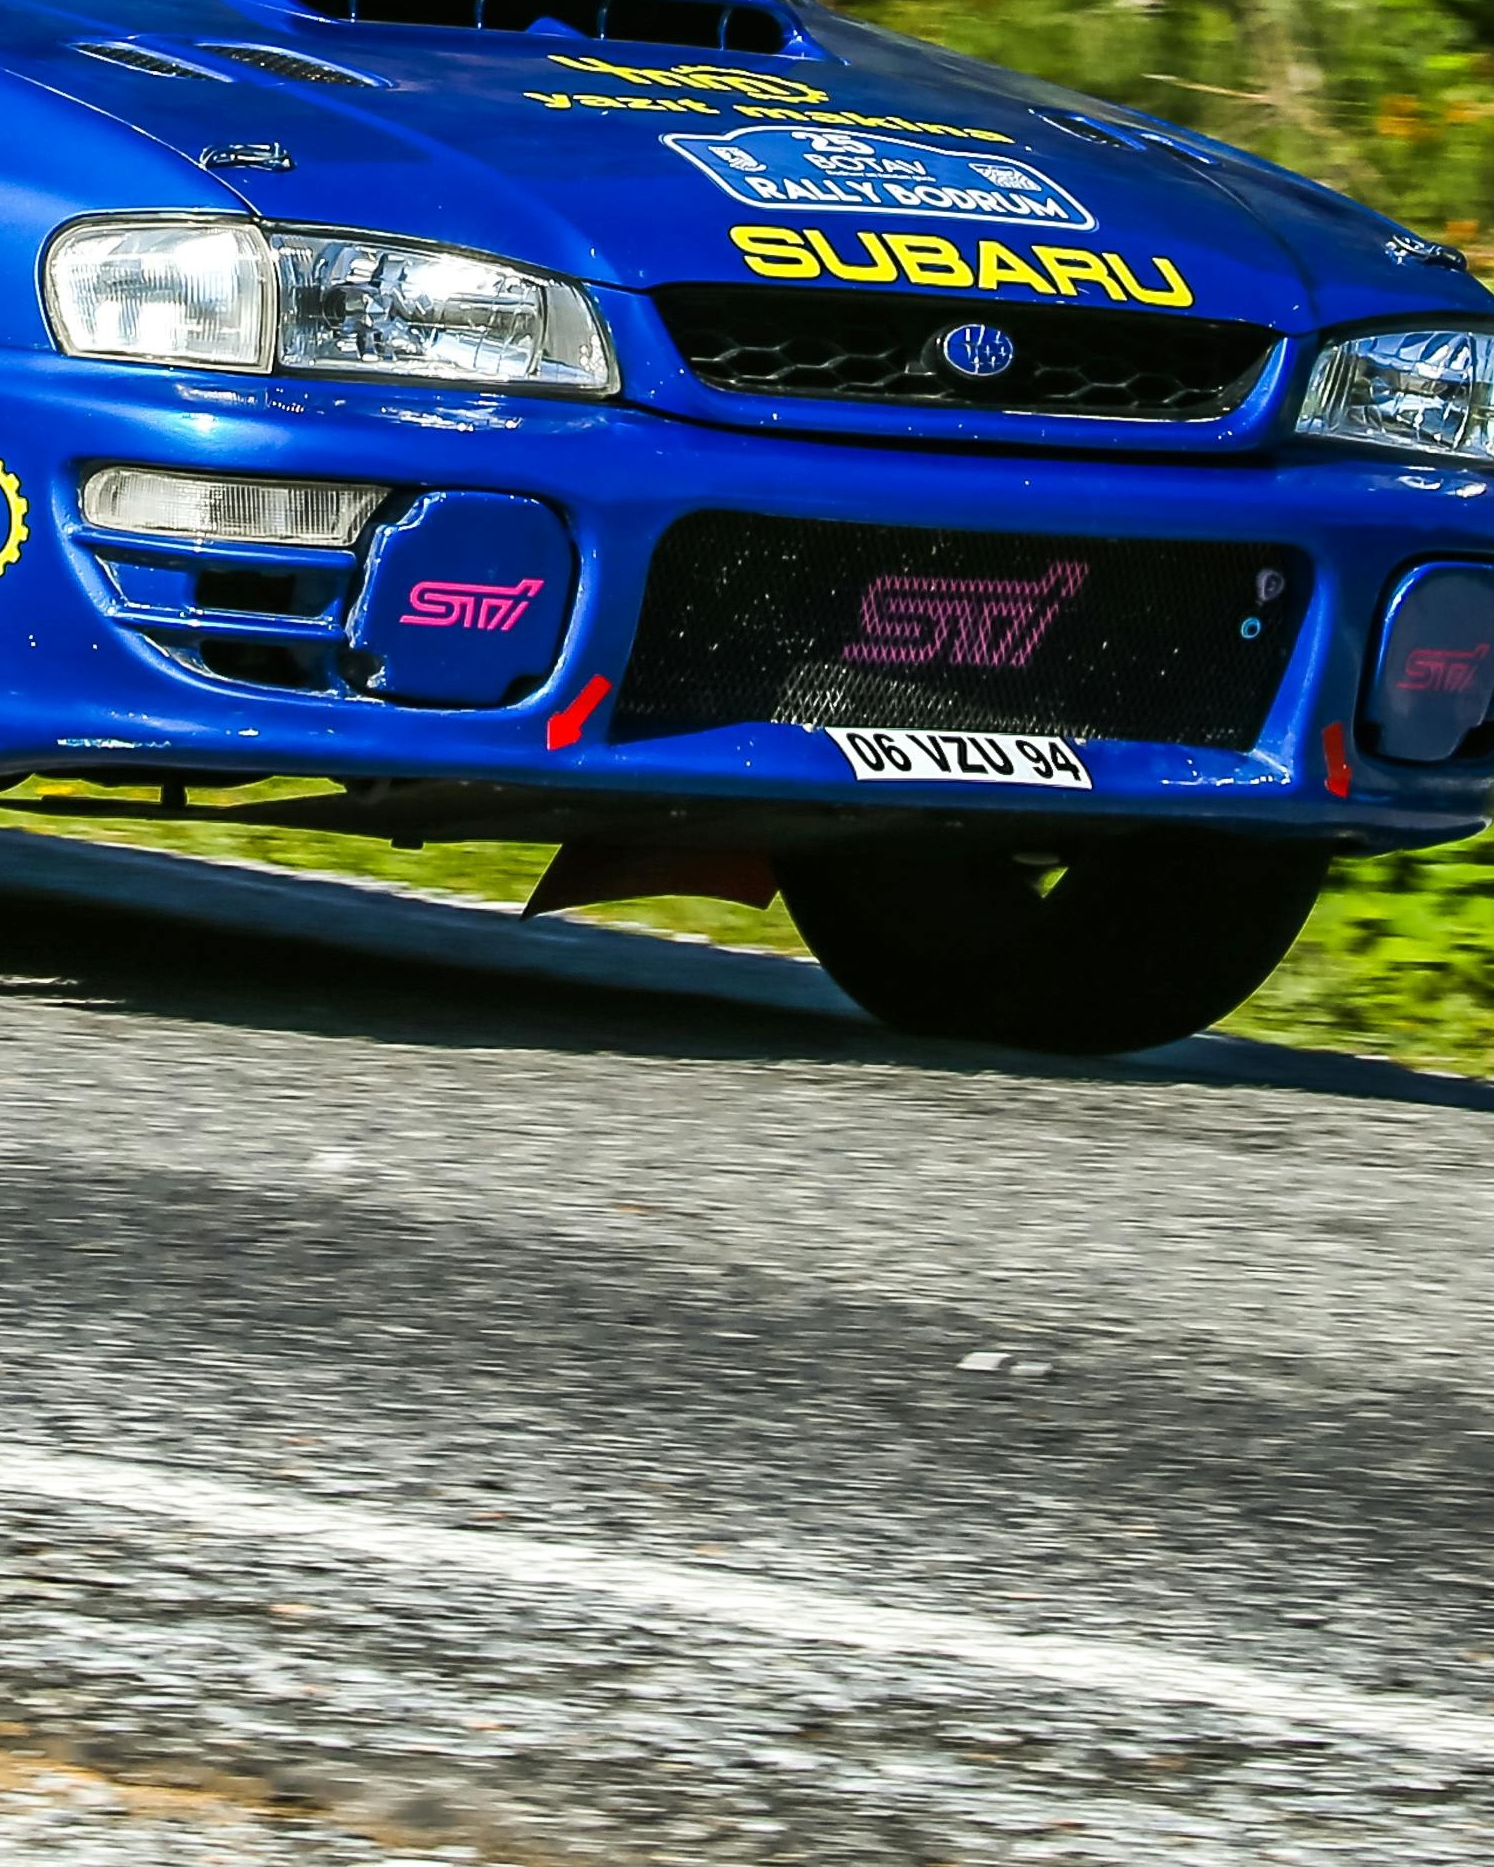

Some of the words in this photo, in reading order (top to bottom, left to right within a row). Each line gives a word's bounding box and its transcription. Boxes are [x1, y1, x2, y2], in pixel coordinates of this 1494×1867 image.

[733, 104, 1016, 144] makina
[791, 131, 875, 156] 25
[804, 153, 927, 176] BOTAV
[744, 175, 886, 204] RALLY
[884, 182, 1069, 220] BODRUM
[728, 225, 1194, 308] SUBARU
[845, 732, 912, 772] 06
[905, 734, 1015, 776] VZU
[1014, 739, 1082, 782] 94
